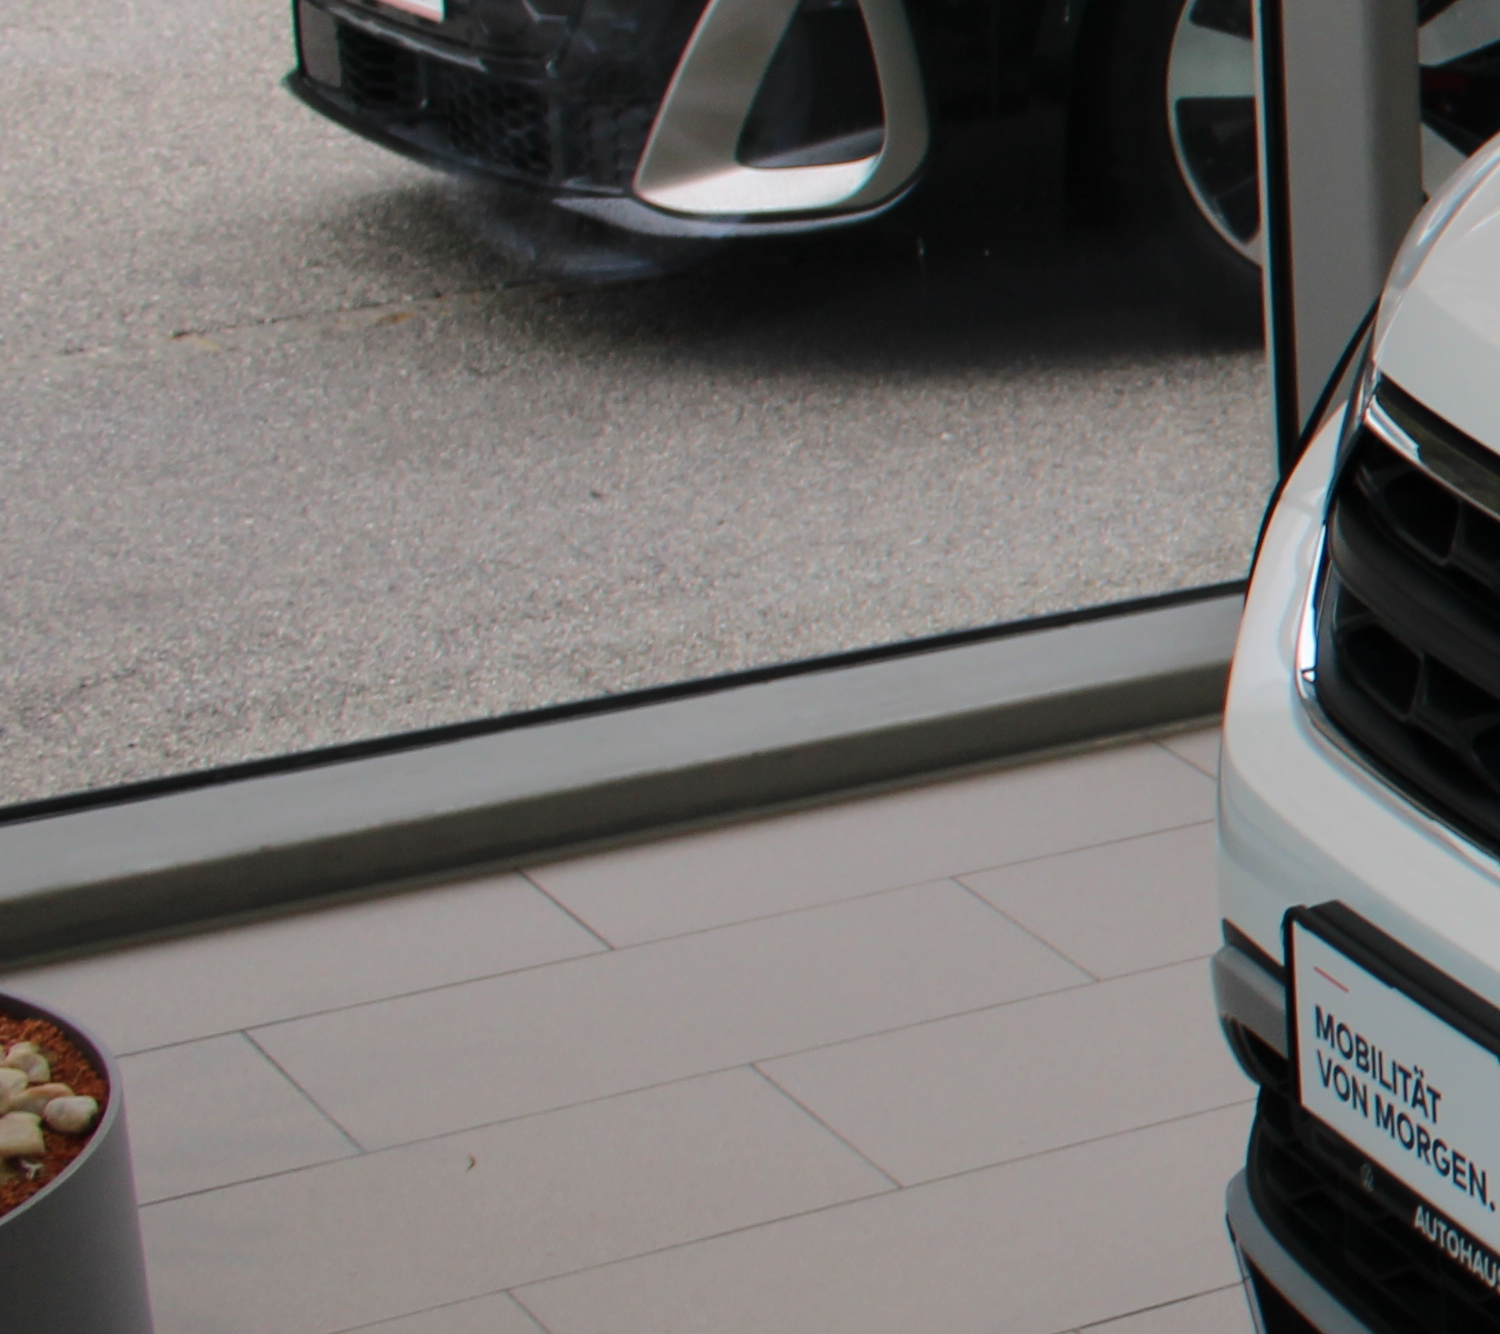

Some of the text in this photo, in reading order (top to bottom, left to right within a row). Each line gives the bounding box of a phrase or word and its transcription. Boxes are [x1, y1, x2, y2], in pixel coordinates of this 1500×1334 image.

[1314, 1005, 1441, 1124] MOBILITÄT
[1316, 1049, 1496, 1213] VON MORGEN.
